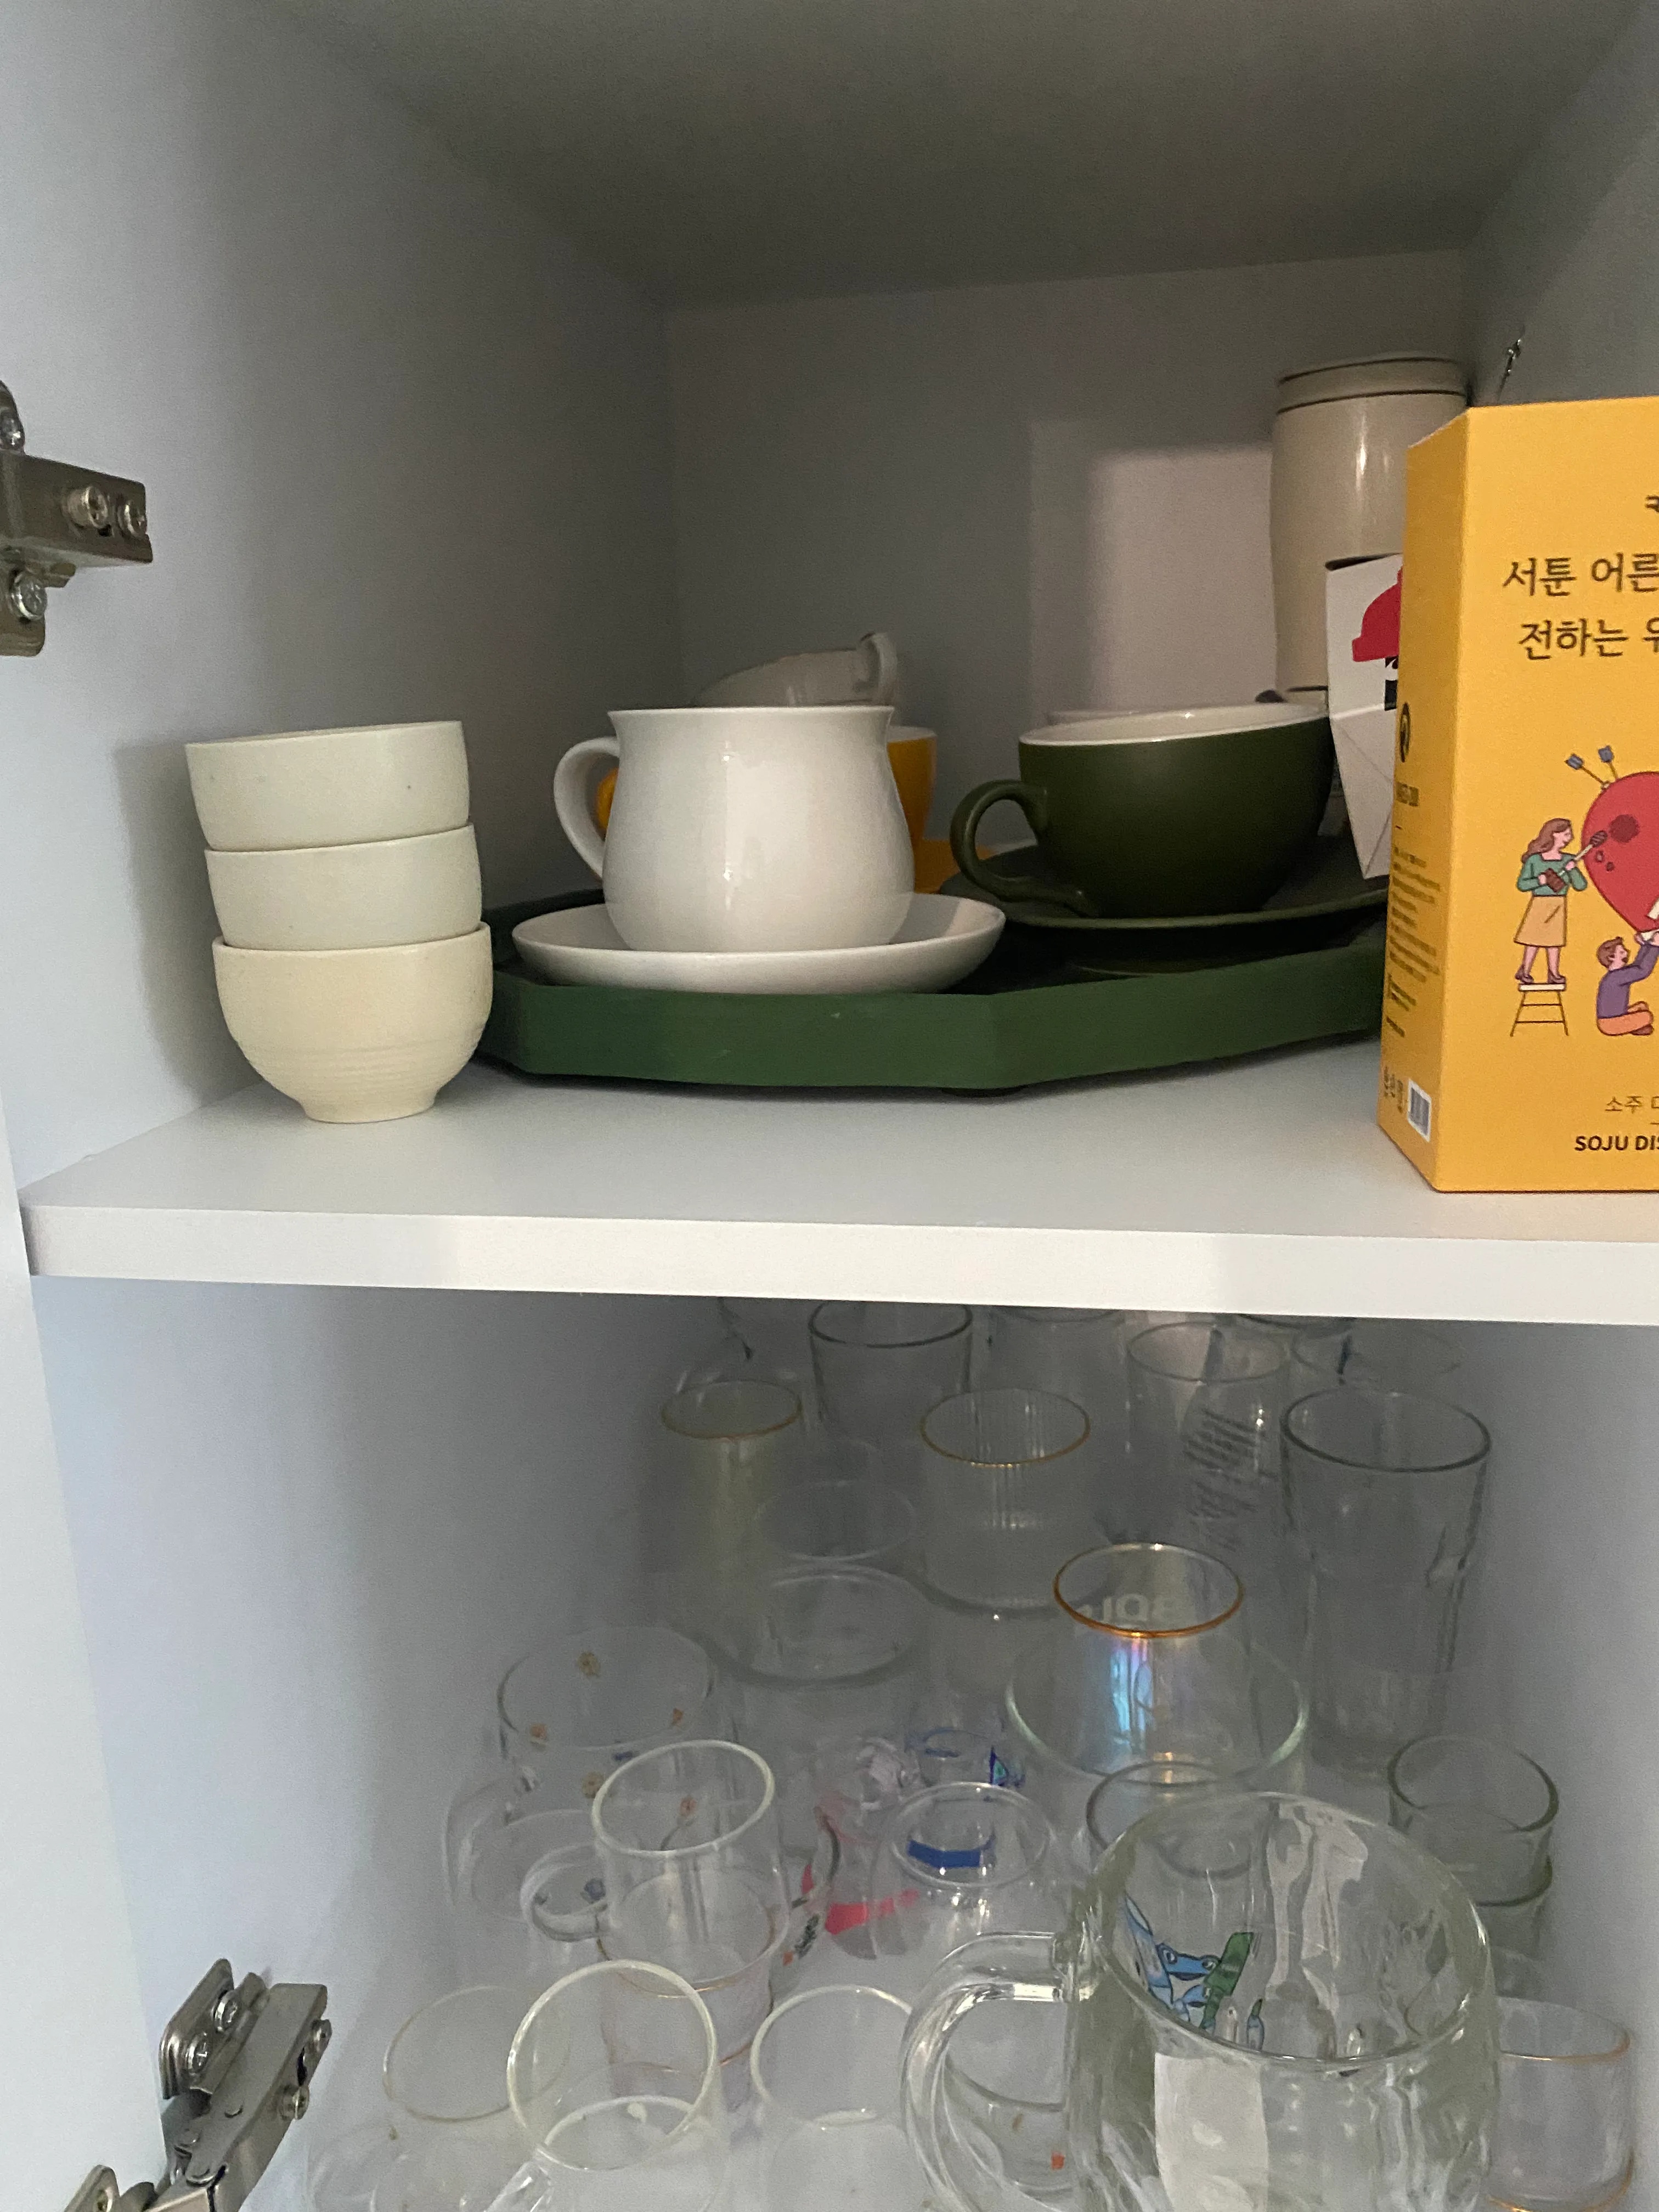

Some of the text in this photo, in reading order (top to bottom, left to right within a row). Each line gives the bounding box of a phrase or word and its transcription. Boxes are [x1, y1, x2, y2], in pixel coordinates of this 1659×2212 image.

[1502, 557, 1578, 597] 서툰
[1518, 617, 1629, 661] 전하는
[1605, 1096, 1642, 1114] 소주
[1575, 1135, 1659, 1151] SOJU DI
